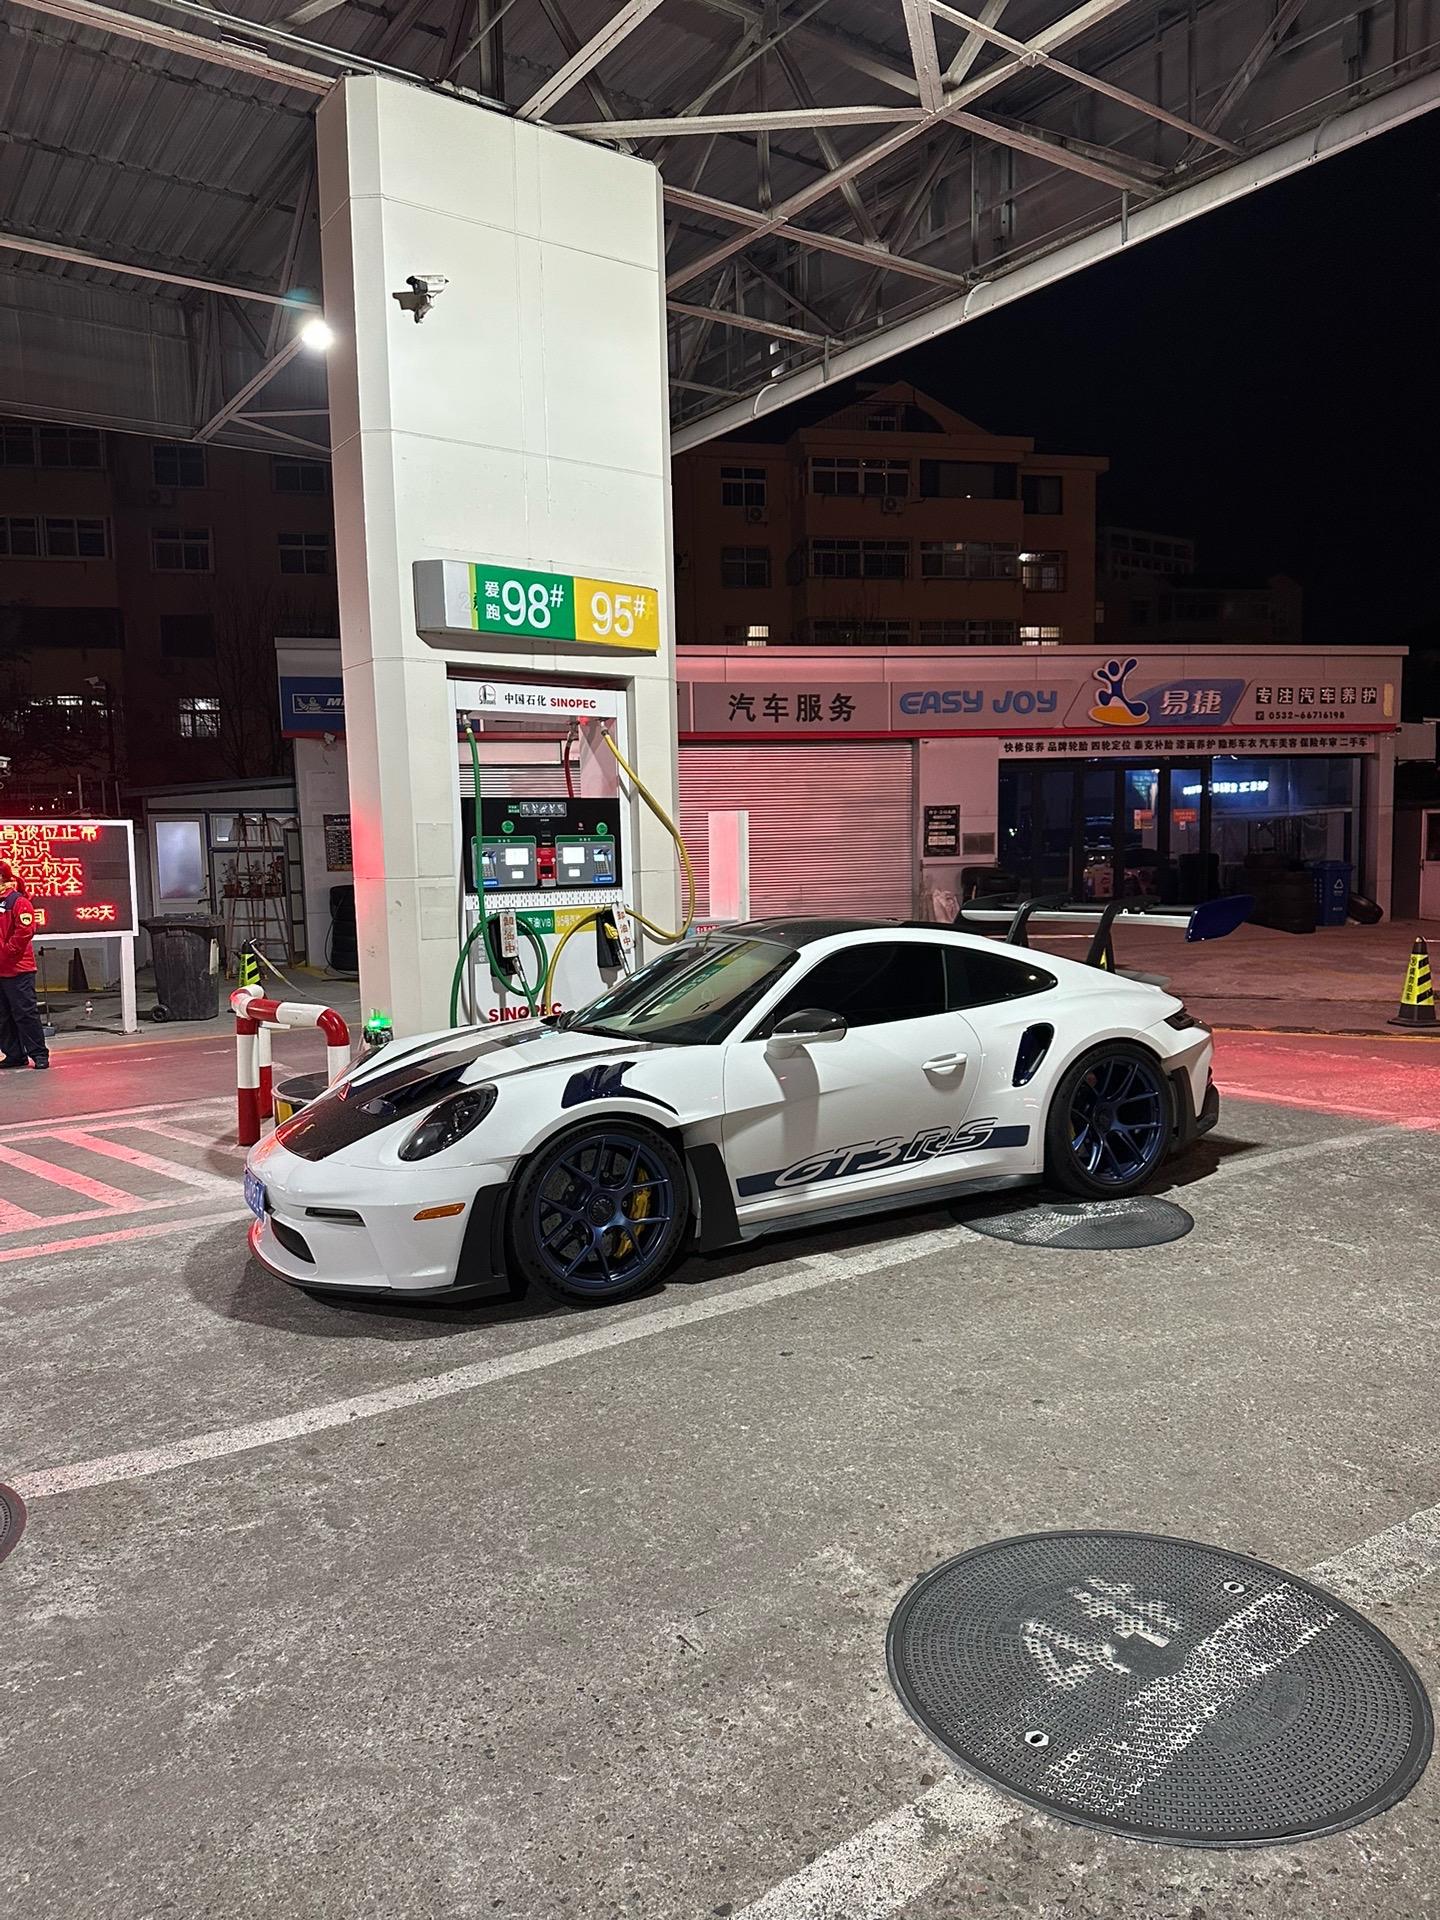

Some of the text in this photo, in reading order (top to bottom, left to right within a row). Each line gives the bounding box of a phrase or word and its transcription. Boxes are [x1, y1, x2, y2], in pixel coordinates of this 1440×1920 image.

[484, 580, 501, 621] 爱跑
[501, 579, 565, 630] 98#
[590, 591, 646, 638] 95#
[504, 692, 597, 709] 中国石化 SINOPEC
[728, 692, 857, 723] 汽车服务
[900, 690, 1058, 714] EASY JOY
[1160, 689, 1222, 716] 易捷
[1256, 687, 1377, 704] 专注汽车养护
[1004, 741, 1044, 752] 快修保养
[1048, 741, 1088, 752] 品牌轮胎
[1091, 740, 1131, 751] 四轮定位
[1340, 737, 1368, 748] 二手车
[76, 905, 116, 921] 323天
